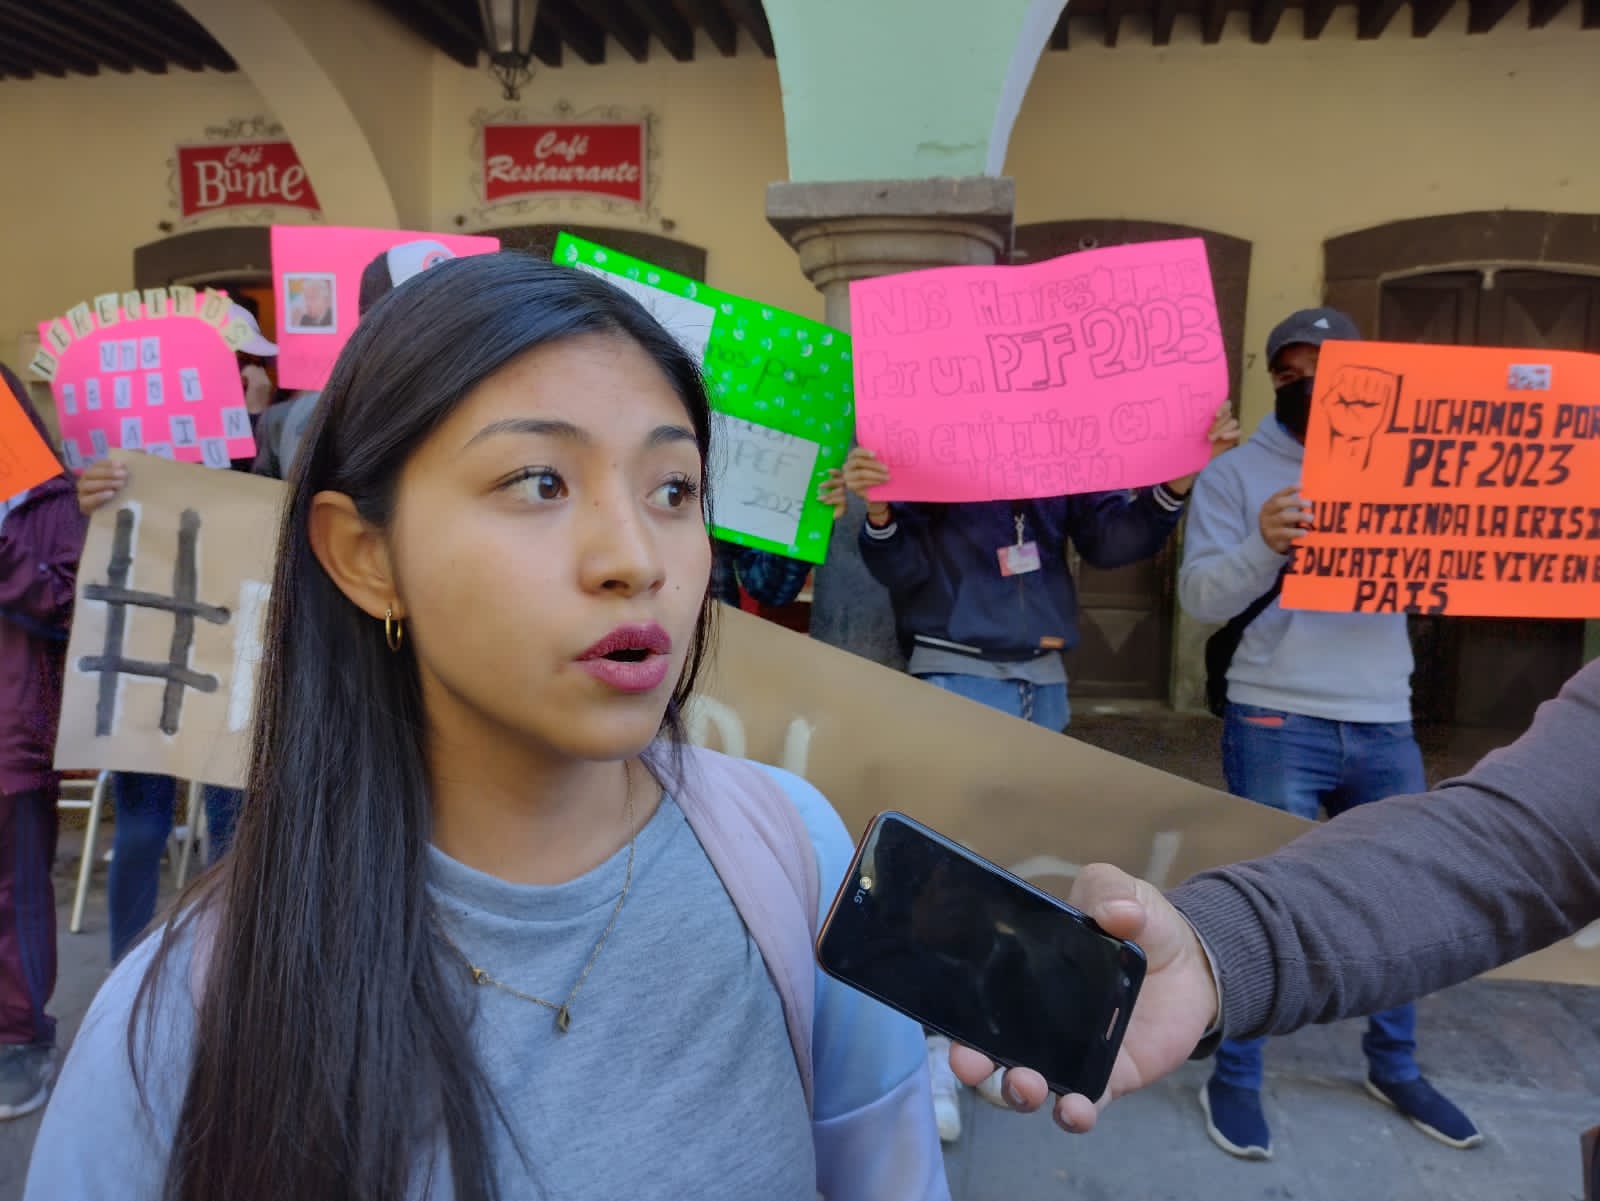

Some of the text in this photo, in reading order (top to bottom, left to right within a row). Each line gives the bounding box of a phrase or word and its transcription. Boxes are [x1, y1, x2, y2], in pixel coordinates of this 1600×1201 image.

[224, 146, 263, 168] Café
[534, 131, 590, 162] Café
[193, 160, 305, 207] Bunte
[487, 155, 640, 183] Restaurante
[1080, 295, 1224, 379] 2023
[1385, 374, 1543, 438] LUCHAMOS
[1403, 438, 1575, 488] PEF 2023
[1356, 503, 1470, 537] ATIENDA
[1475, 505, 1509, 537] LA
[1286, 545, 1432, 580] EDUCATIVA
[1437, 550, 1487, 581] QUE
[1493, 552, 1558, 583] VIVE
[1561, 554, 1588, 583] EN
[1353, 580, 1449, 616] PAIS
[853, 888, 867, 905] LG
